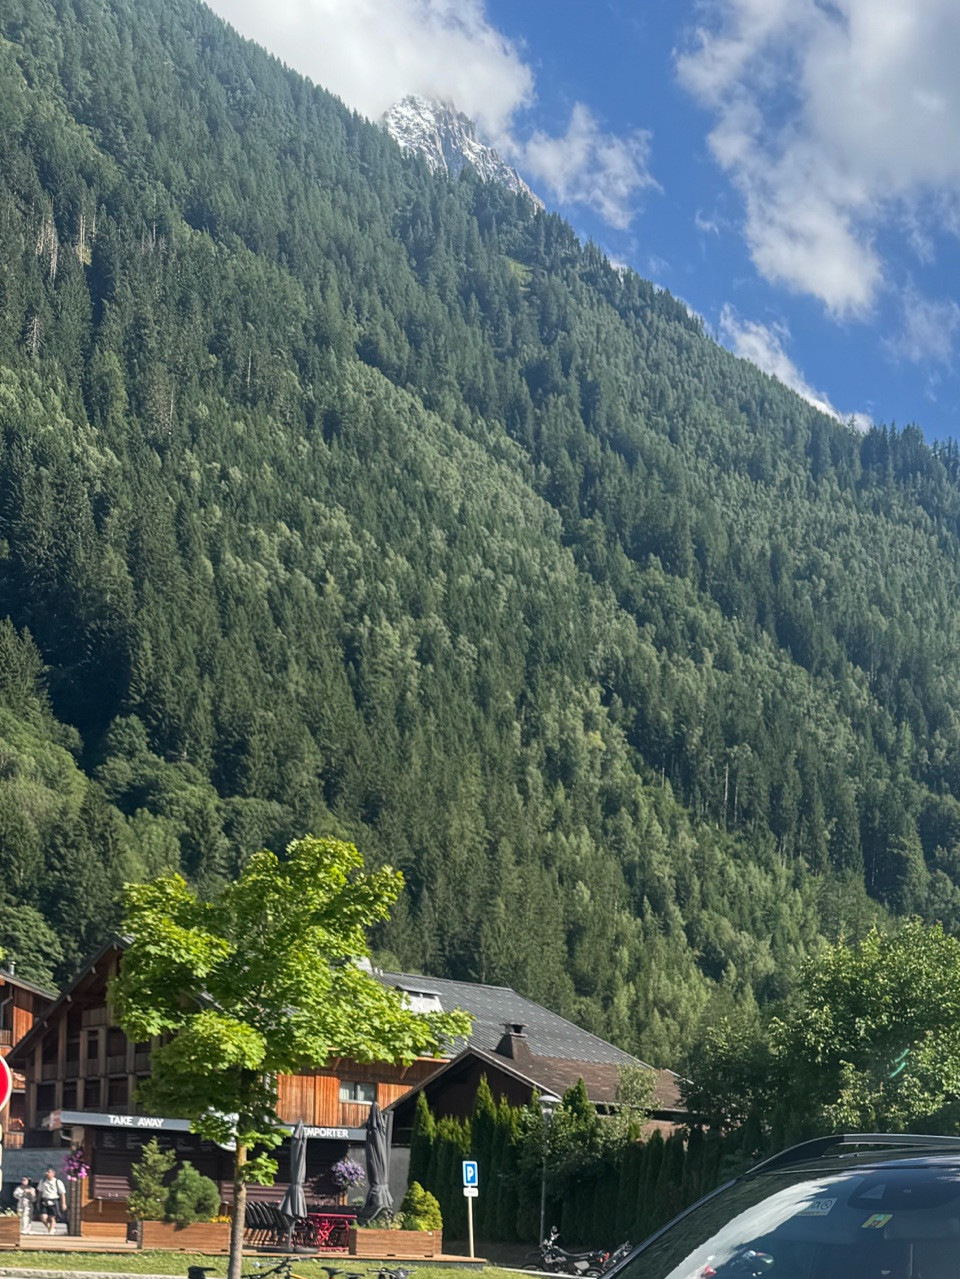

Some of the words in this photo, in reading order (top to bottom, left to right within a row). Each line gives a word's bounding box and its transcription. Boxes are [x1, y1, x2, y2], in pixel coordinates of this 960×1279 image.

[108, 1115, 133, 1126] TAKE
[137, 1117, 163, 1128] AWAY
[466, 1165, 474, 1181] P
